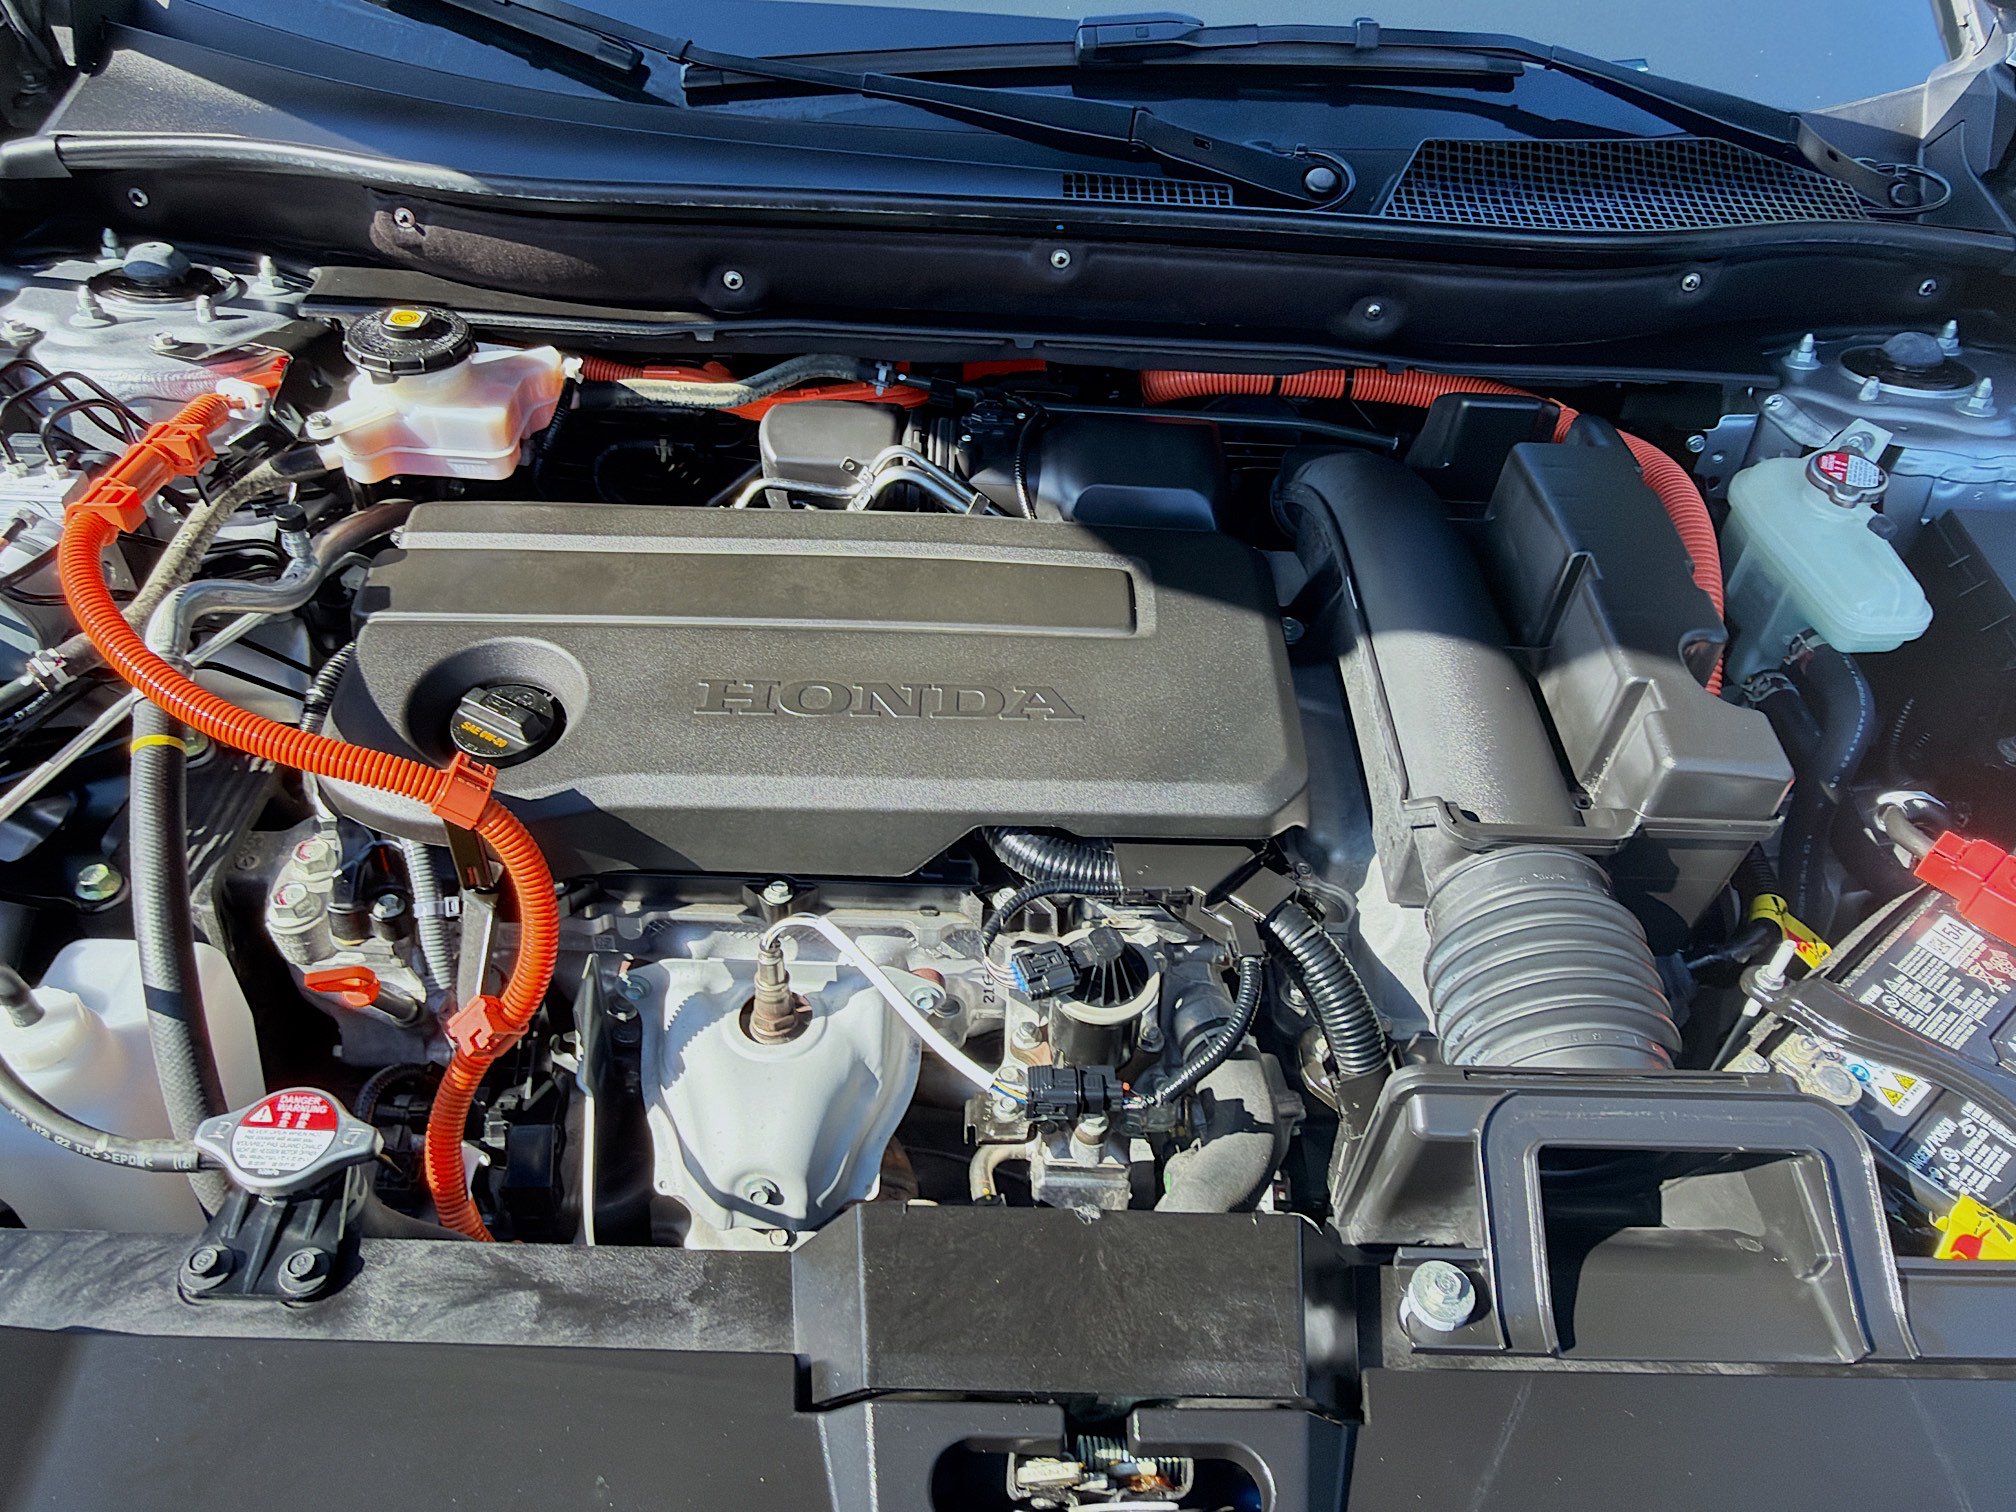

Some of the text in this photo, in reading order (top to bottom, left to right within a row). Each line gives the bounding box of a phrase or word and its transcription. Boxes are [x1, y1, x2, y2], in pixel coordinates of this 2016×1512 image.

[694, 679, 1085, 721] HONDA
[461, 721, 482, 735] SAE
[1942, 922, 1967, 940] 5A
[279, 1095, 323, 1105] DANGER
[75, 1144, 100, 1159] TPC
[1907, 1117, 1959, 1170] ANGER/POISON
